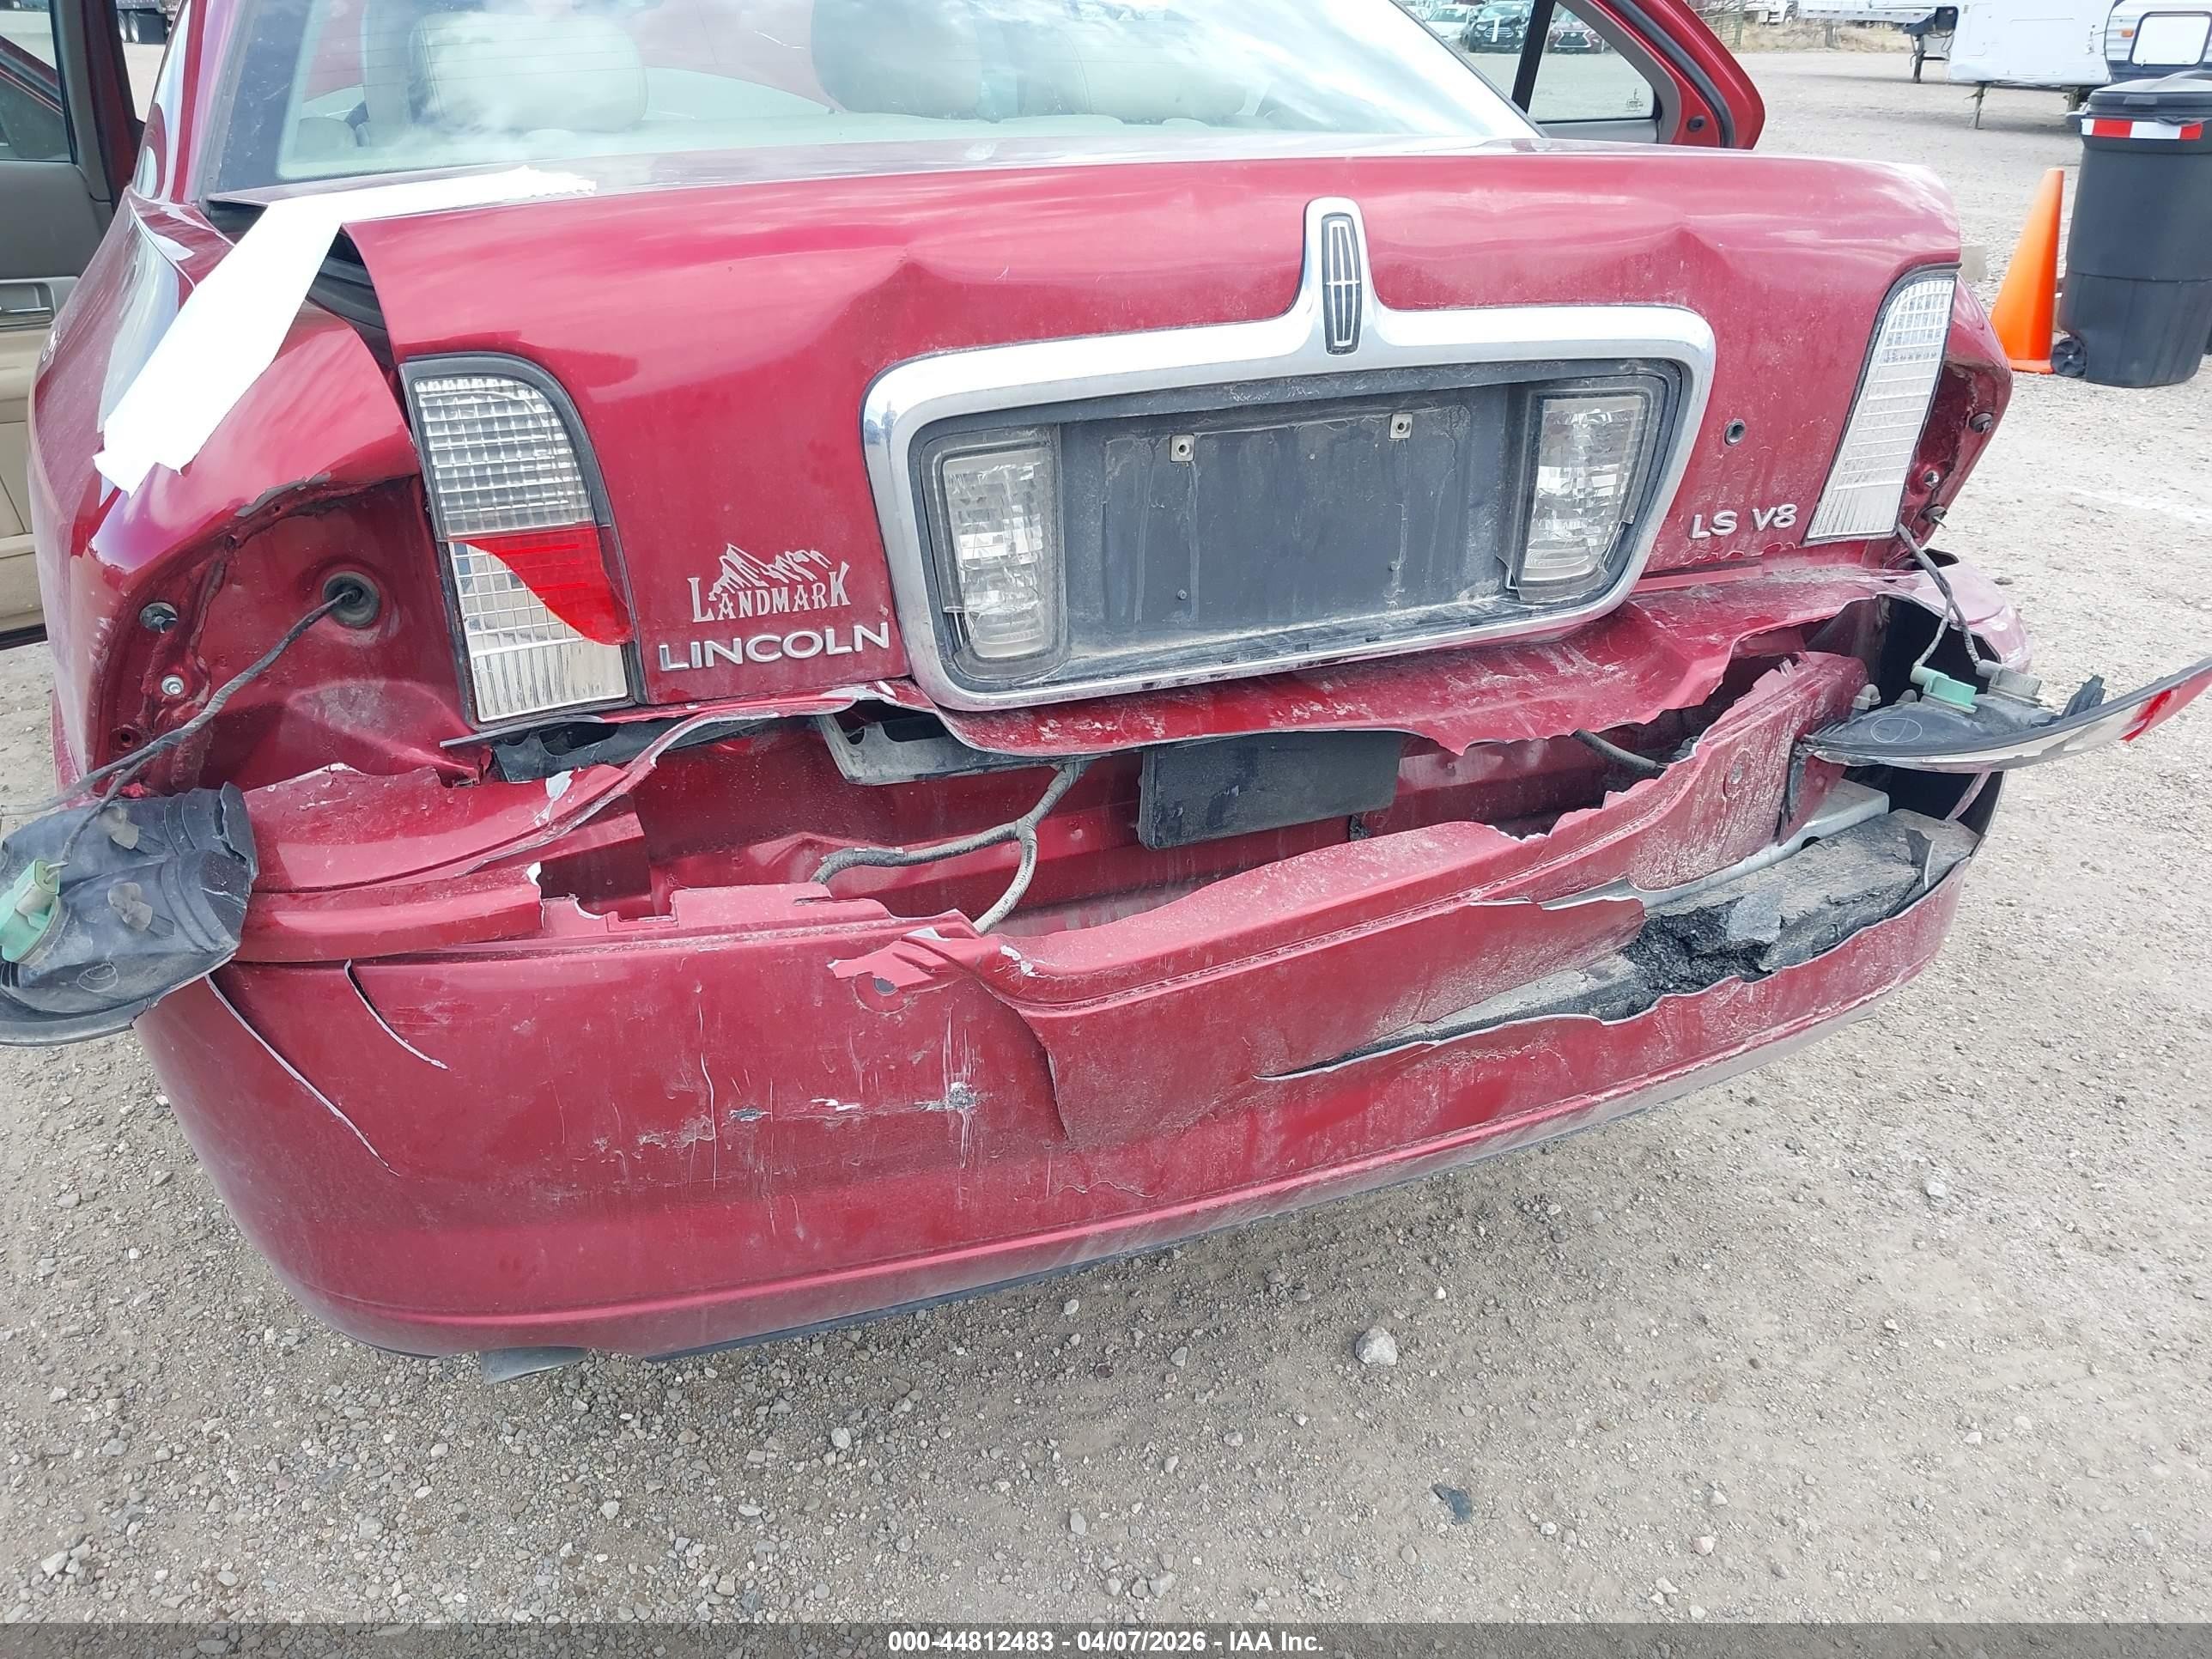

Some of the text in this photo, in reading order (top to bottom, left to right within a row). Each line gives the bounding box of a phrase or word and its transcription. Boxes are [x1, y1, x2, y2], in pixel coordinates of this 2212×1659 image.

[1691, 503, 1797, 538] LS V8
[687, 561, 851, 623] LANDMARK
[659, 622, 890, 672] LINCOLN
